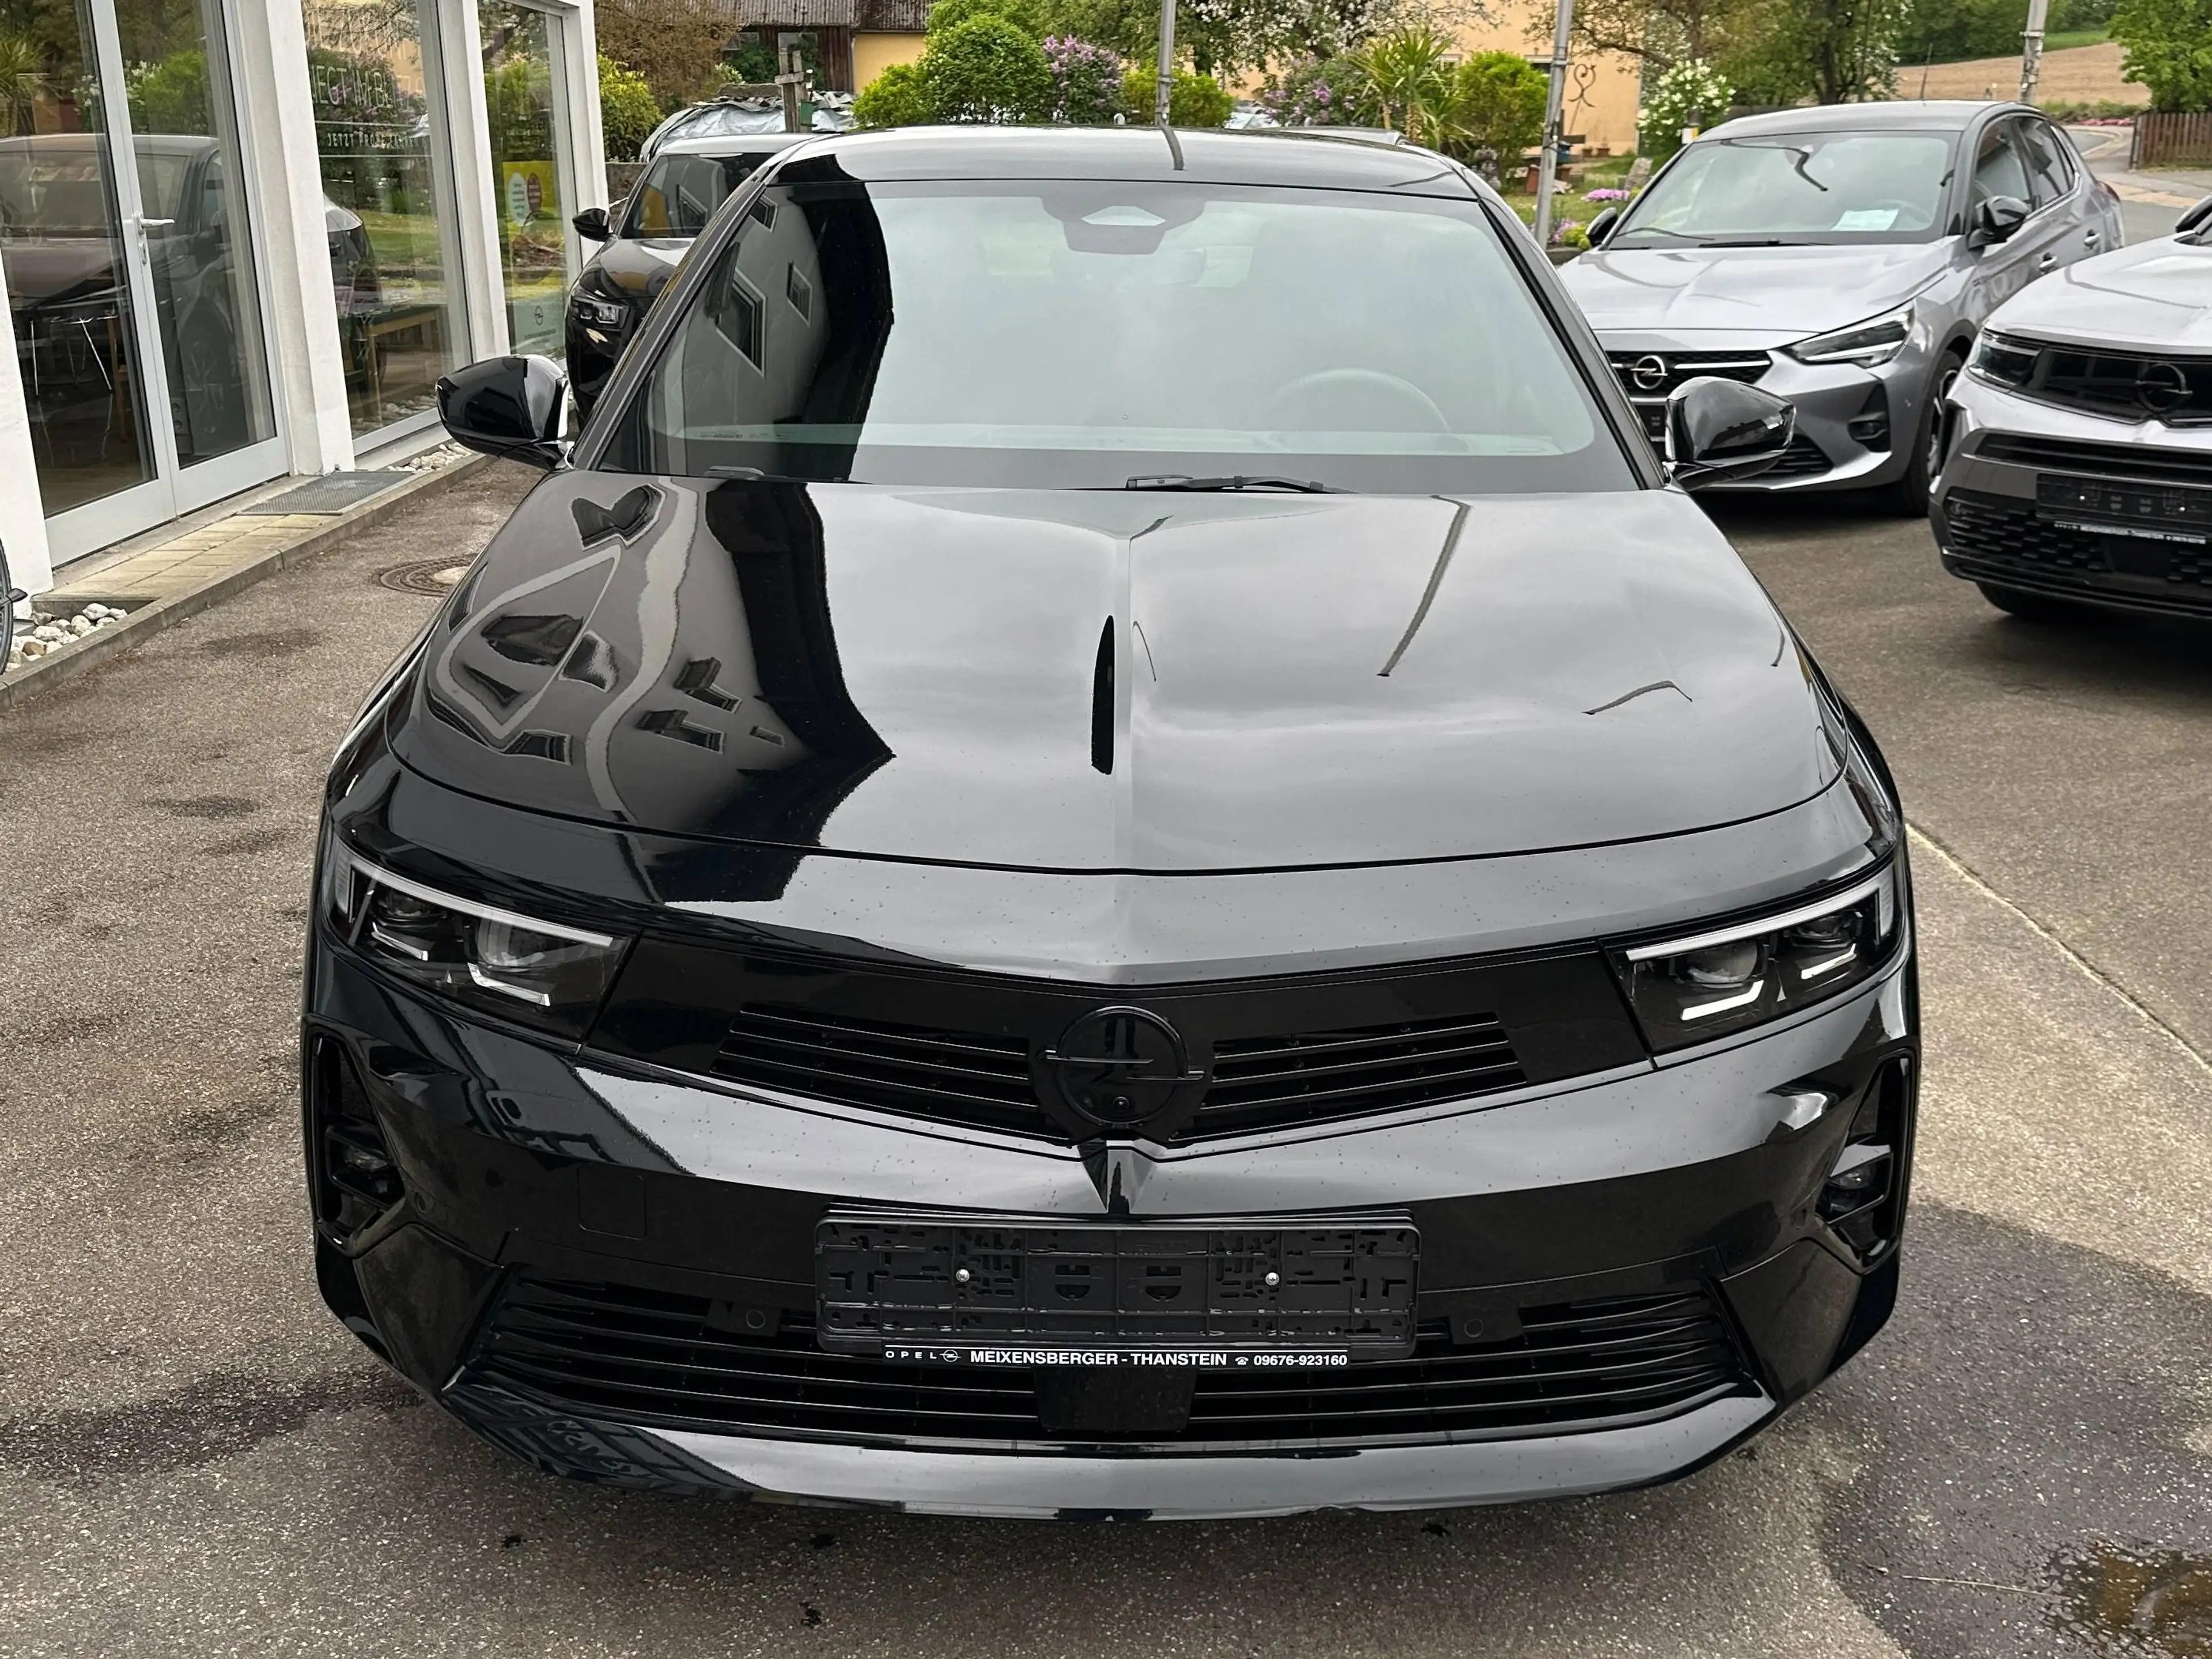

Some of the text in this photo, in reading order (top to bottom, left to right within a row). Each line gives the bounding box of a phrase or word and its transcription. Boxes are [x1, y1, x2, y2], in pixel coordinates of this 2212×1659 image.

[327, 132, 354, 147] JETZT
[885, 1350, 937, 1361] OPEL
[970, 1350, 1119, 1365] MEIXENSBERGER
[1130, 1353, 1227, 1366] THANSTEIN
[1253, 1354, 1348, 1366] 09676-923160
